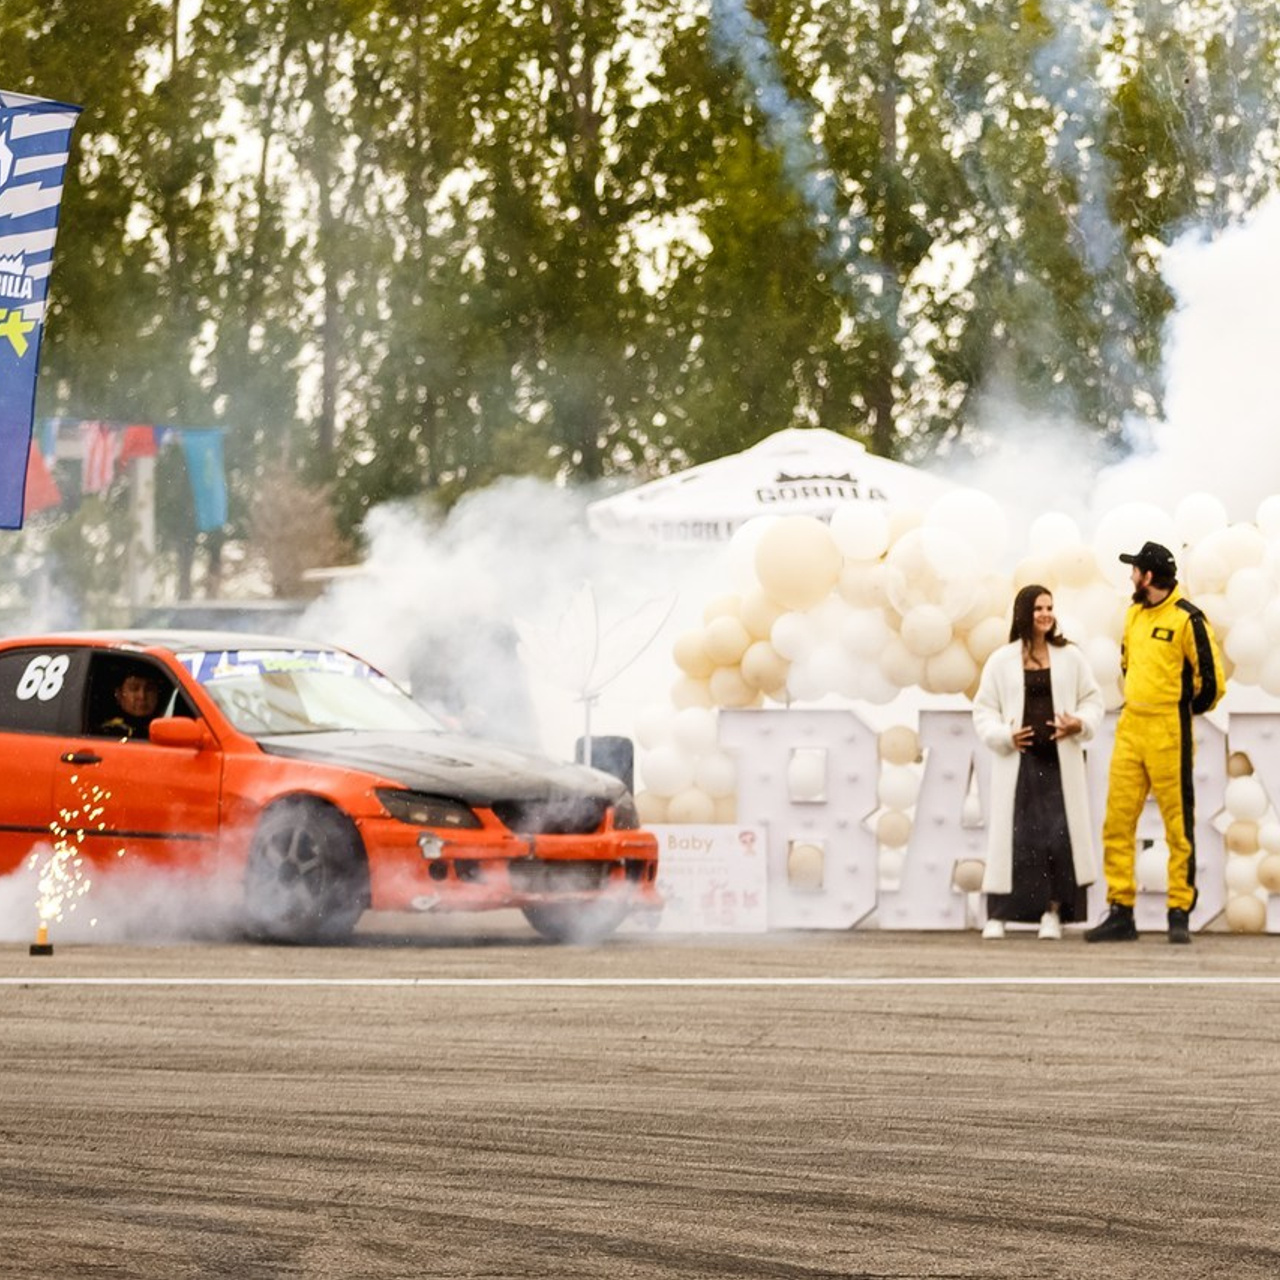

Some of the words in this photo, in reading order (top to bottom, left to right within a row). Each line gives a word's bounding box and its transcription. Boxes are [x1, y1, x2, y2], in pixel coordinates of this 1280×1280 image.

[0, 274, 32, 299] ILLA
[755, 485, 887, 502] GORILLA
[16, 654, 70, 701] 68
[667, 834, 713, 854] Baby
